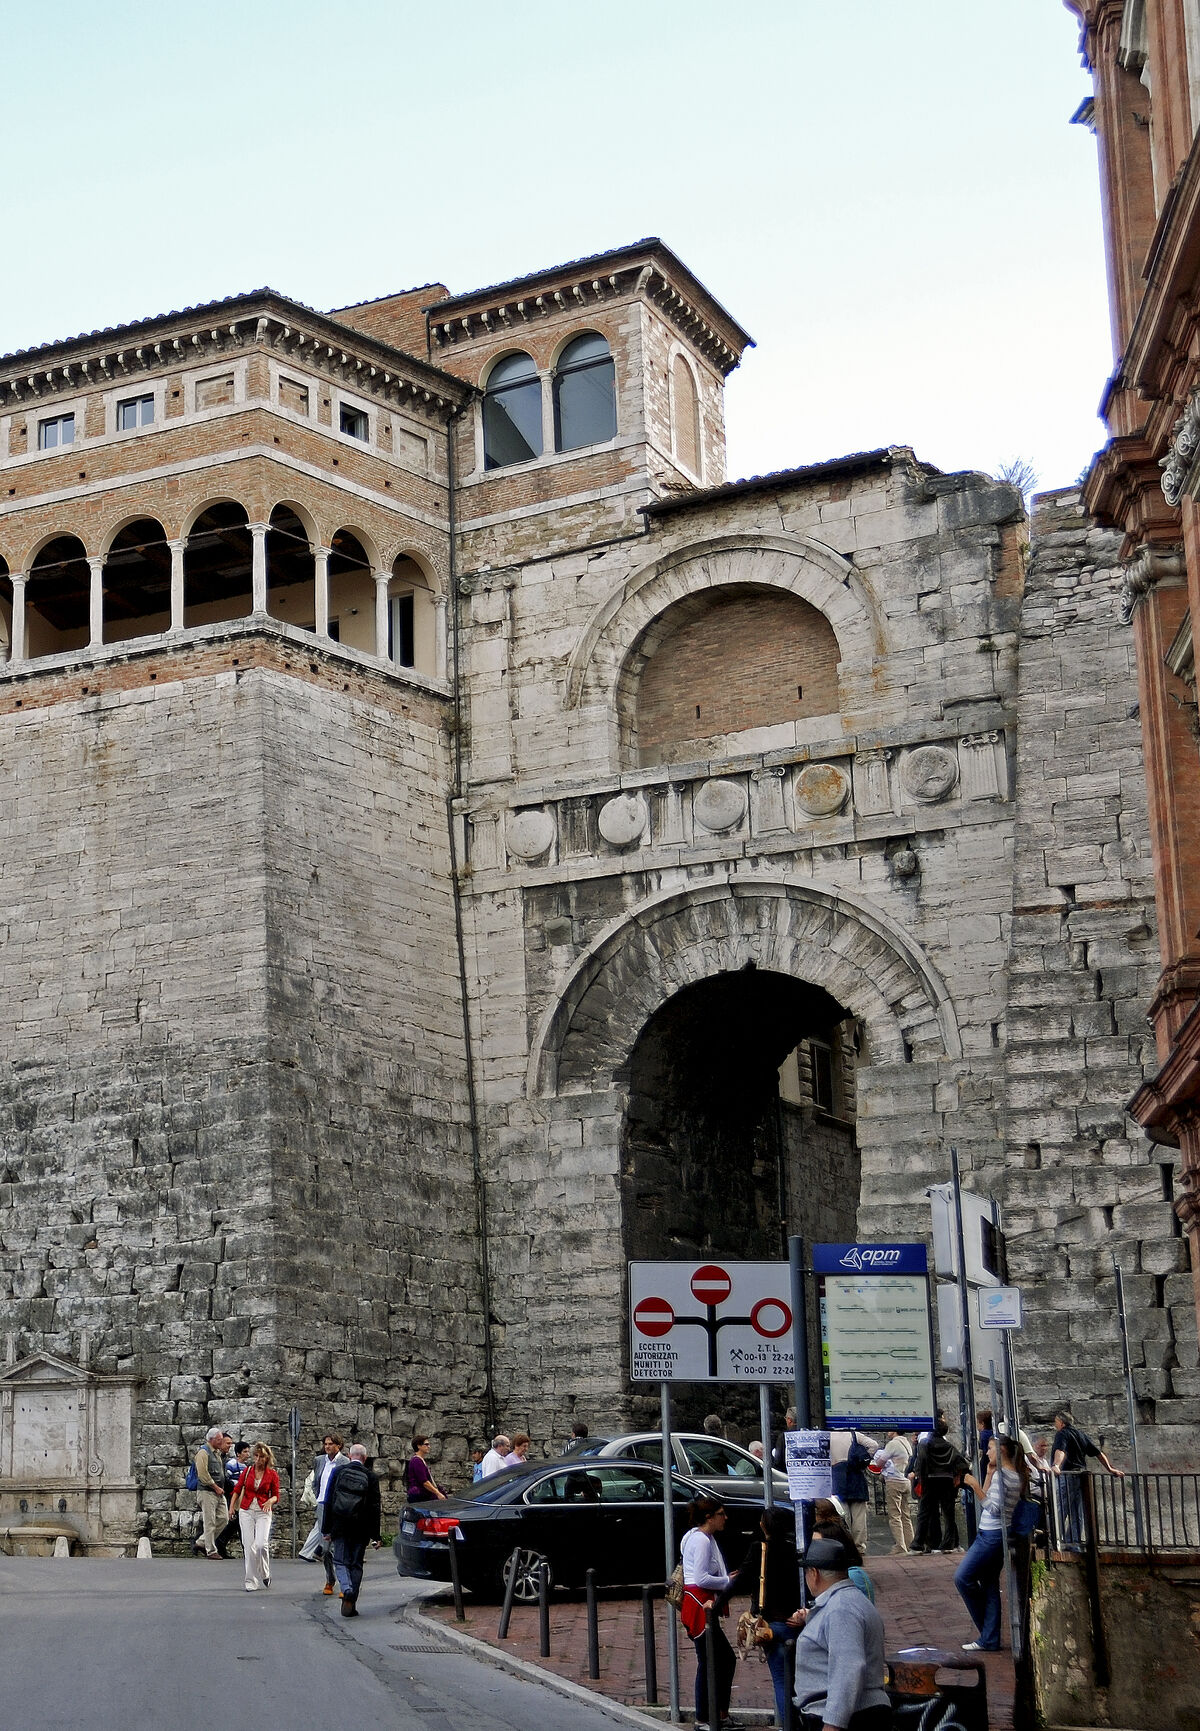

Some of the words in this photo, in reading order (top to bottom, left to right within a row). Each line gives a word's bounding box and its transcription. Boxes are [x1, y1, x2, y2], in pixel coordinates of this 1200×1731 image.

[861, 1249, 900, 1266] apm
[639, 1343, 671, 1351] ECCETTO
[634, 1352, 678, 1360] AUTORIZZATI
[634, 1369, 673, 1377] DETECTOR
[773, 1367, 794, 1375] 22-24
